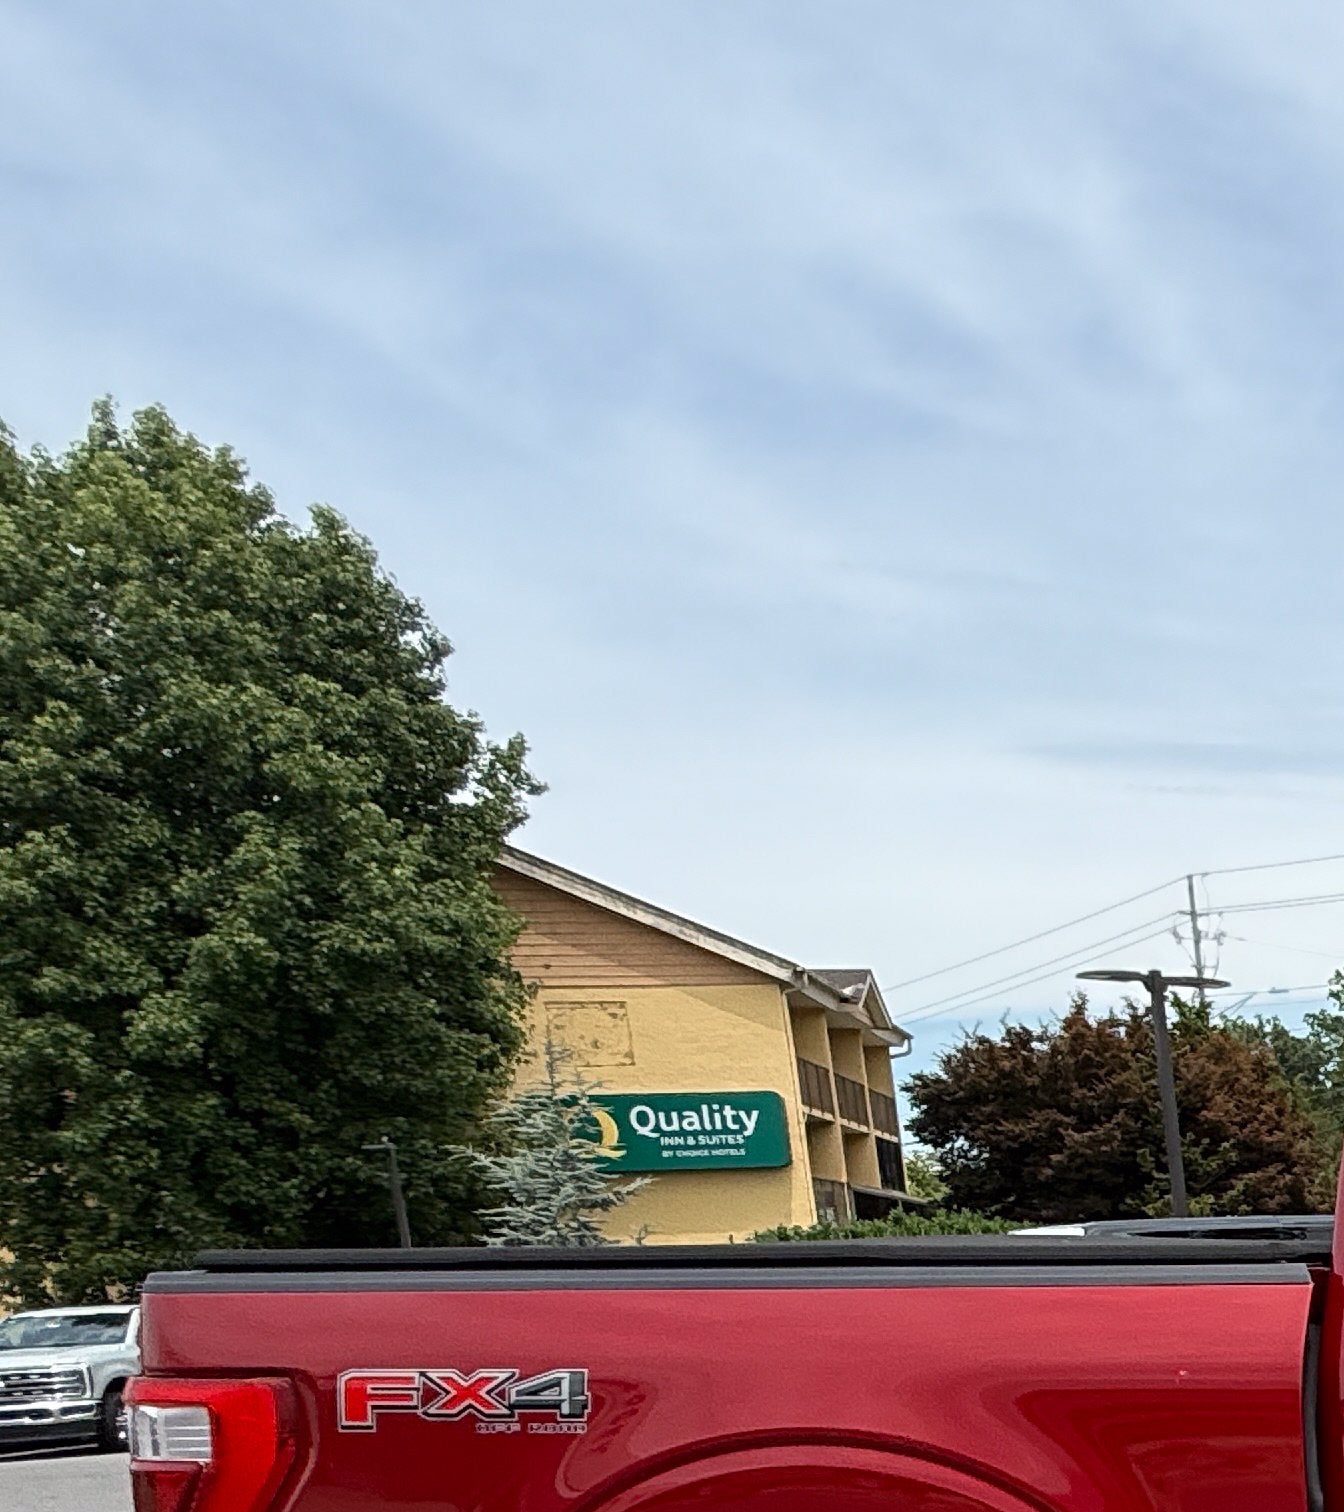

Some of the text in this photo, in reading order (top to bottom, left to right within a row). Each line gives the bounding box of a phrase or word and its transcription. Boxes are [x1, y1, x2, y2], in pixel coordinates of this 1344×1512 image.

[629, 1104, 760, 1138] Quality
[660, 1134, 745, 1146] INN & SUITES
[337, 1368, 590, 1432] FX4
